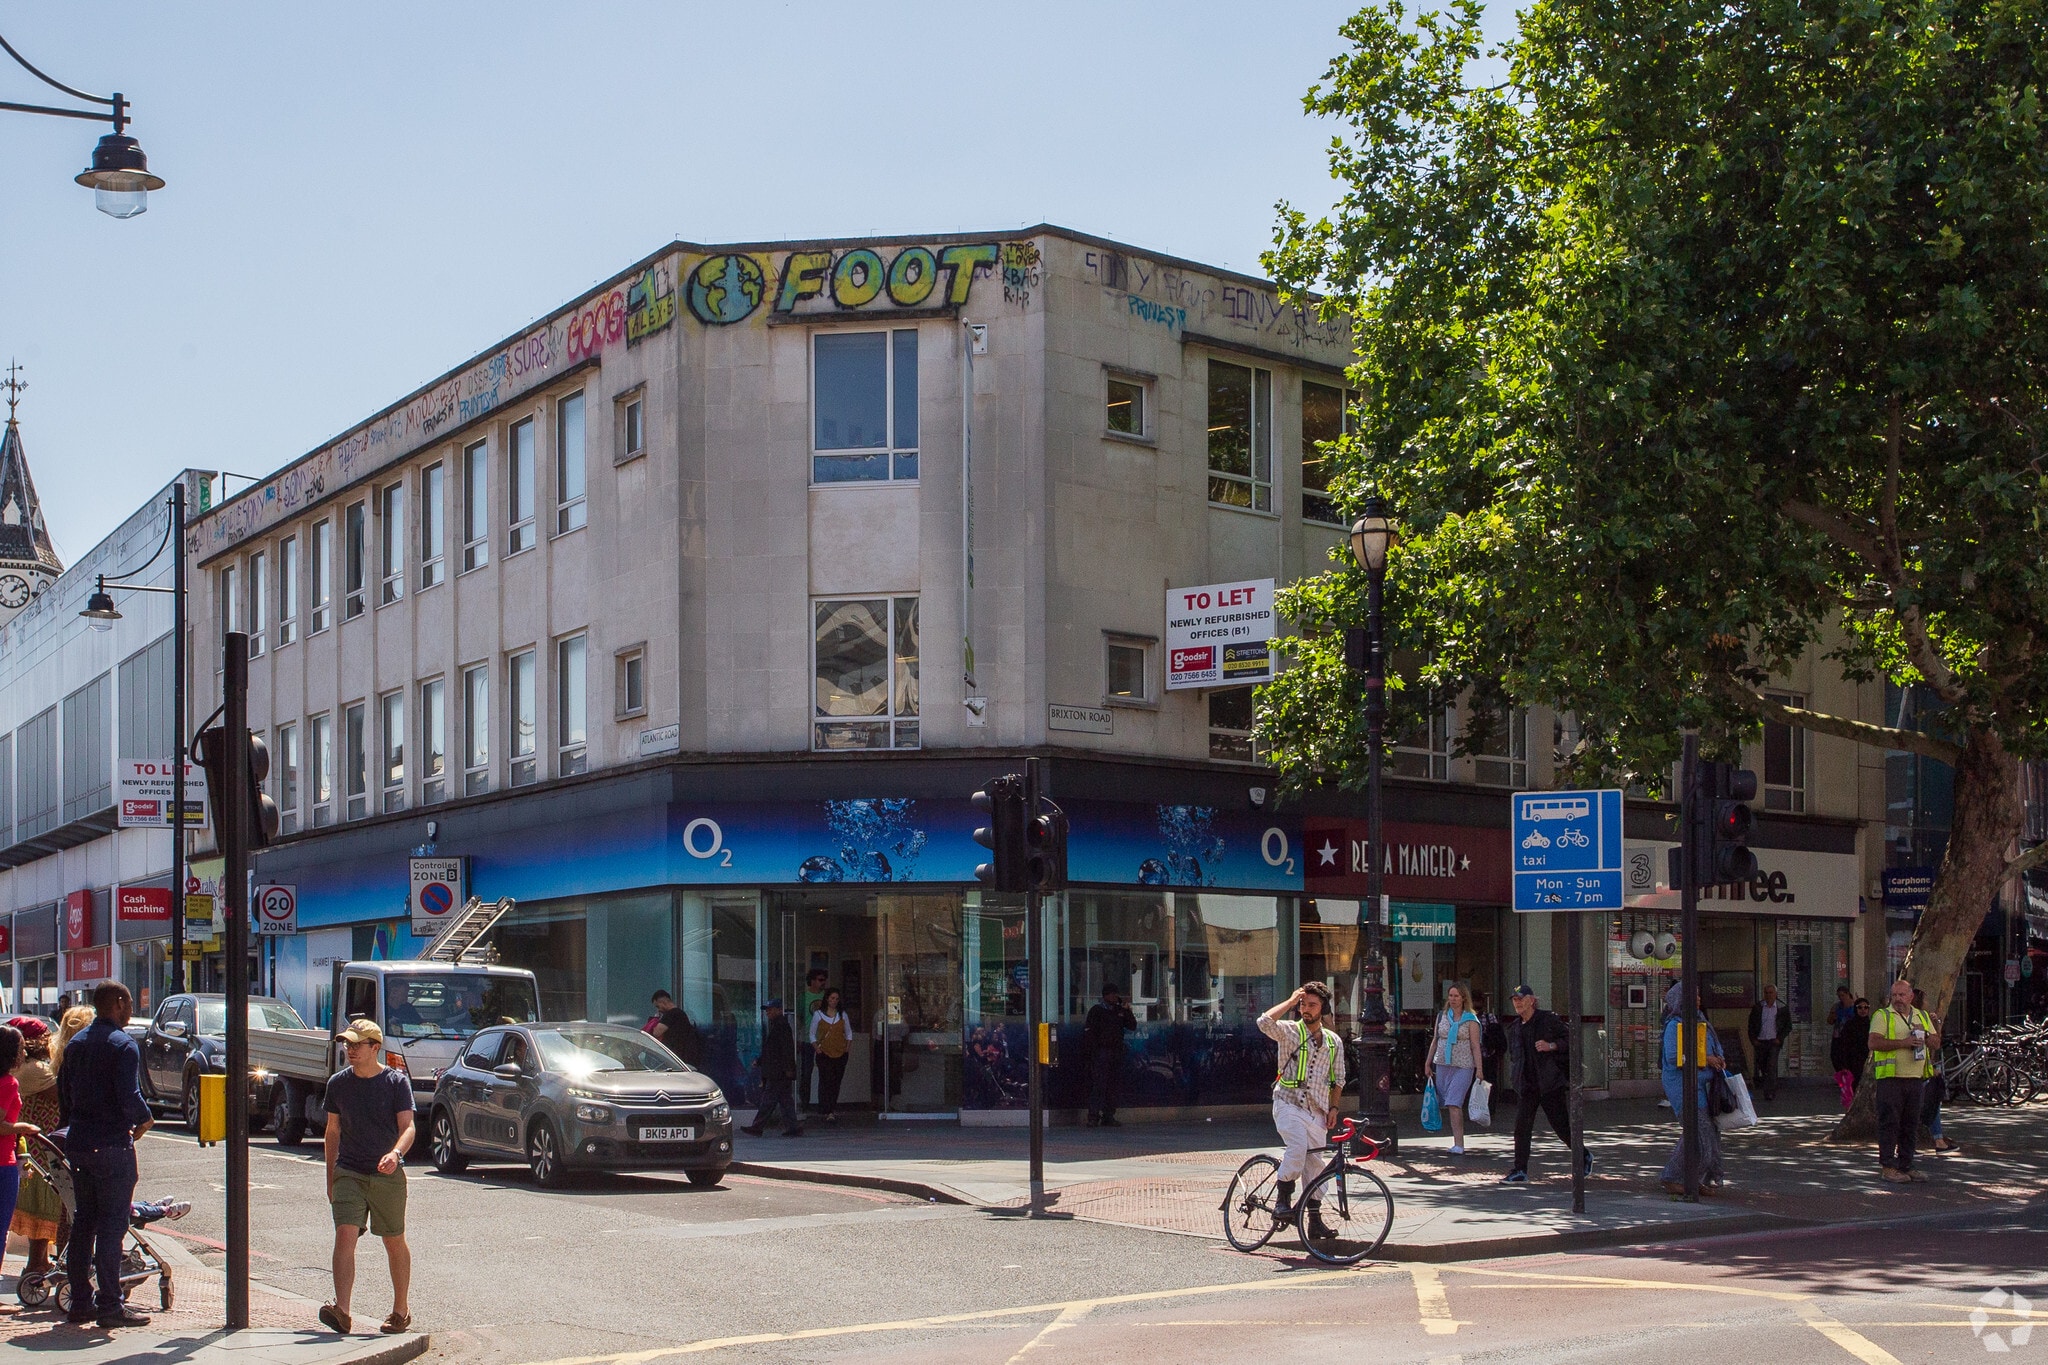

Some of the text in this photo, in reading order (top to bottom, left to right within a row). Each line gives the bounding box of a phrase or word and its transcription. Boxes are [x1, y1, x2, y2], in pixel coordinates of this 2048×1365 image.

[775, 243, 1001, 312] FOOT
[1183, 587, 1256, 611] TO LET
[1170, 610, 1271, 629] NEWLY REFURBISHED
[1190, 626, 1250, 640] OFFICES (B1)
[1174, 651, 1209, 670] goodsir
[1170, 673, 1183, 681] 020
[1184, 671, 1200, 680] 7566
[1202, 669, 1217, 679] 6455
[1051, 708, 1111, 723] BRIXTON ROAD
[641, 728, 678, 745] ATLANTIC ROAD
[134, 763, 193, 776] TO LT
[682, 817, 733, 868] O2
[1261, 827, 1294, 876] O2
[413, 861, 458, 870] Controlled
[1384, 842, 1393, 875] A
[1399, 843, 1456, 878] MANGER
[1522, 855, 1546, 866] taxi
[413, 869, 457, 881] ZONE B
[1891, 876, 1931, 886] Carphone
[1536, 878, 1563, 890] Mon
[1576, 877, 1601, 889] Sun
[1888, 886, 1931, 894] Warehouse
[123, 894, 146, 903] Cash
[267, 896, 290, 911] 20
[1574, 891, 1603, 904] 7pm
[123, 904, 165, 914] machine
[69, 903, 83, 929] Argos
[264, 922, 293, 932] ZONE
[312, 956, 330, 967] HUAWEI
[1621, 962, 1652, 976] Looking
[645, 1128, 689, 1139] BK19 APO
